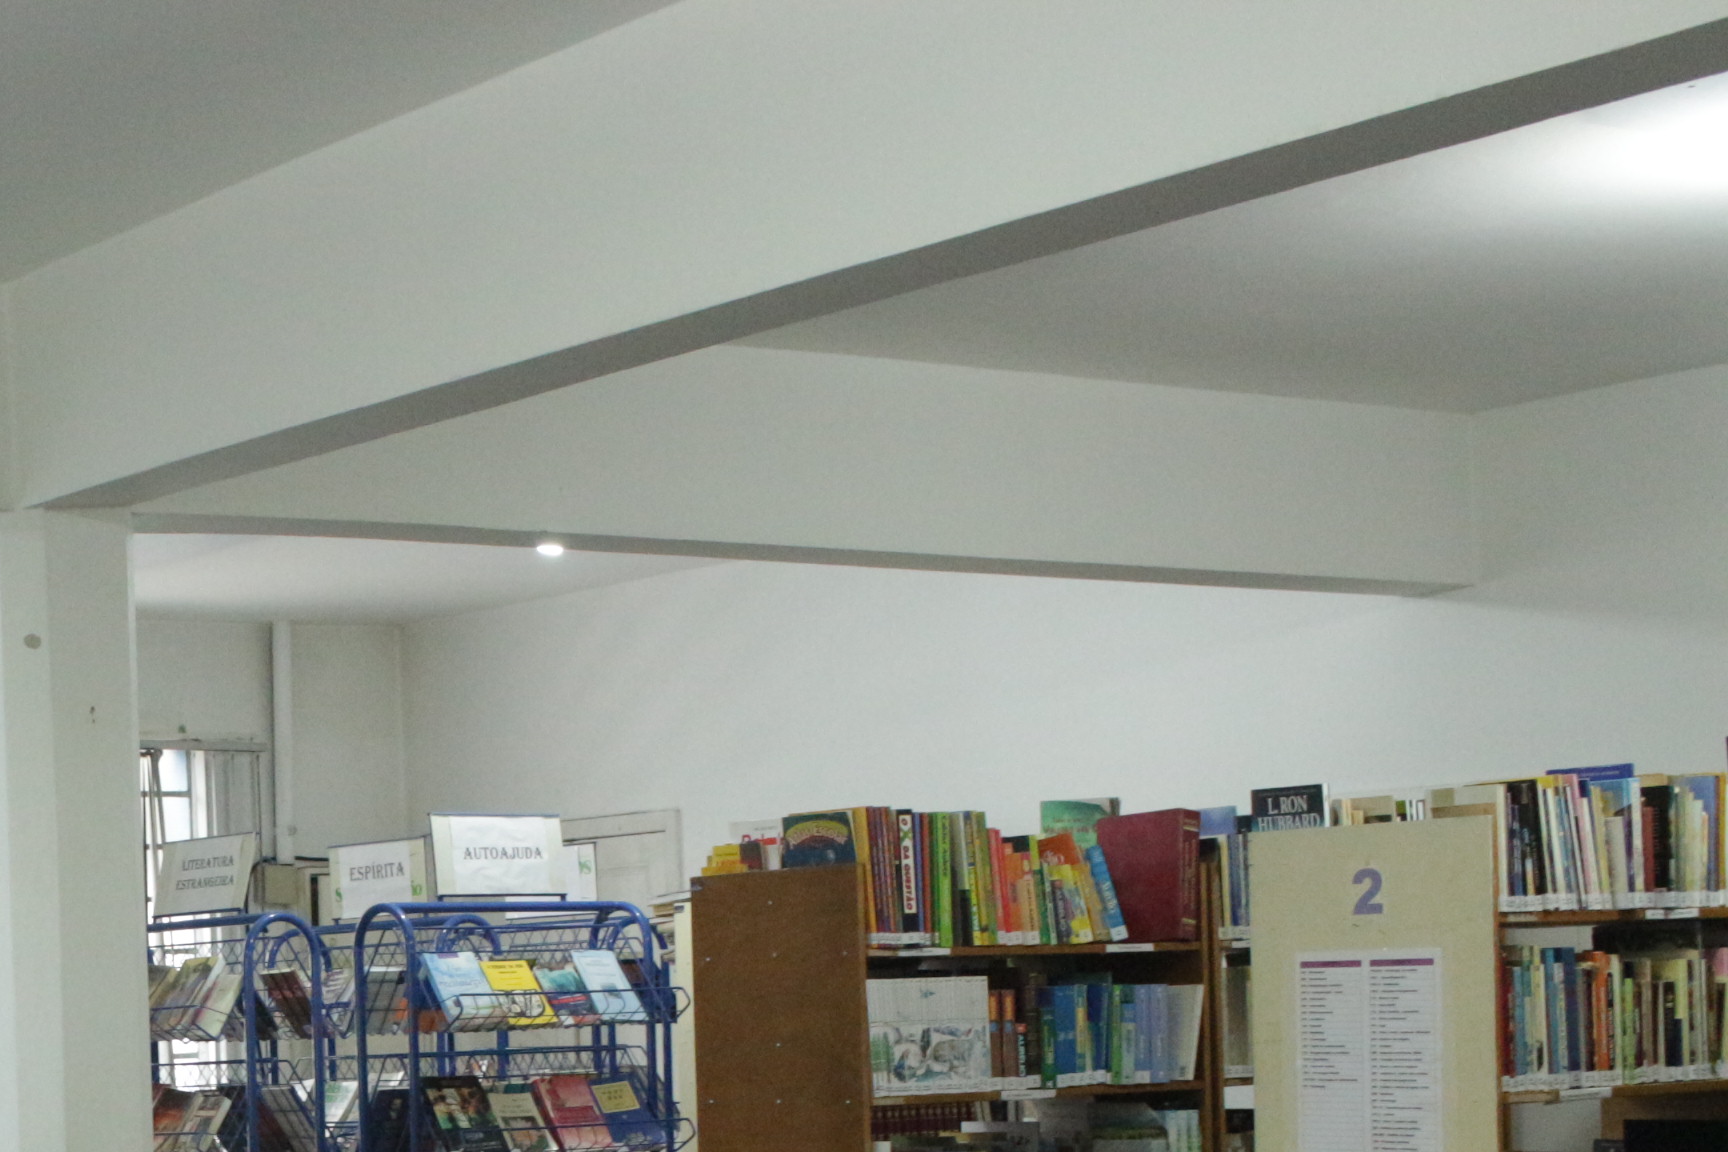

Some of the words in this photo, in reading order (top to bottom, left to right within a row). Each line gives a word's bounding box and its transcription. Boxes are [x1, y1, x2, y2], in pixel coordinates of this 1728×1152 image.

[1280, 795, 1308, 814] RON
[463, 846, 543, 861] AUTOAJUDA
[182, 855, 234, 872] LITERATURA
[349, 861, 406, 882] ESPÍRITA
[1351, 867, 1384, 916] 2
